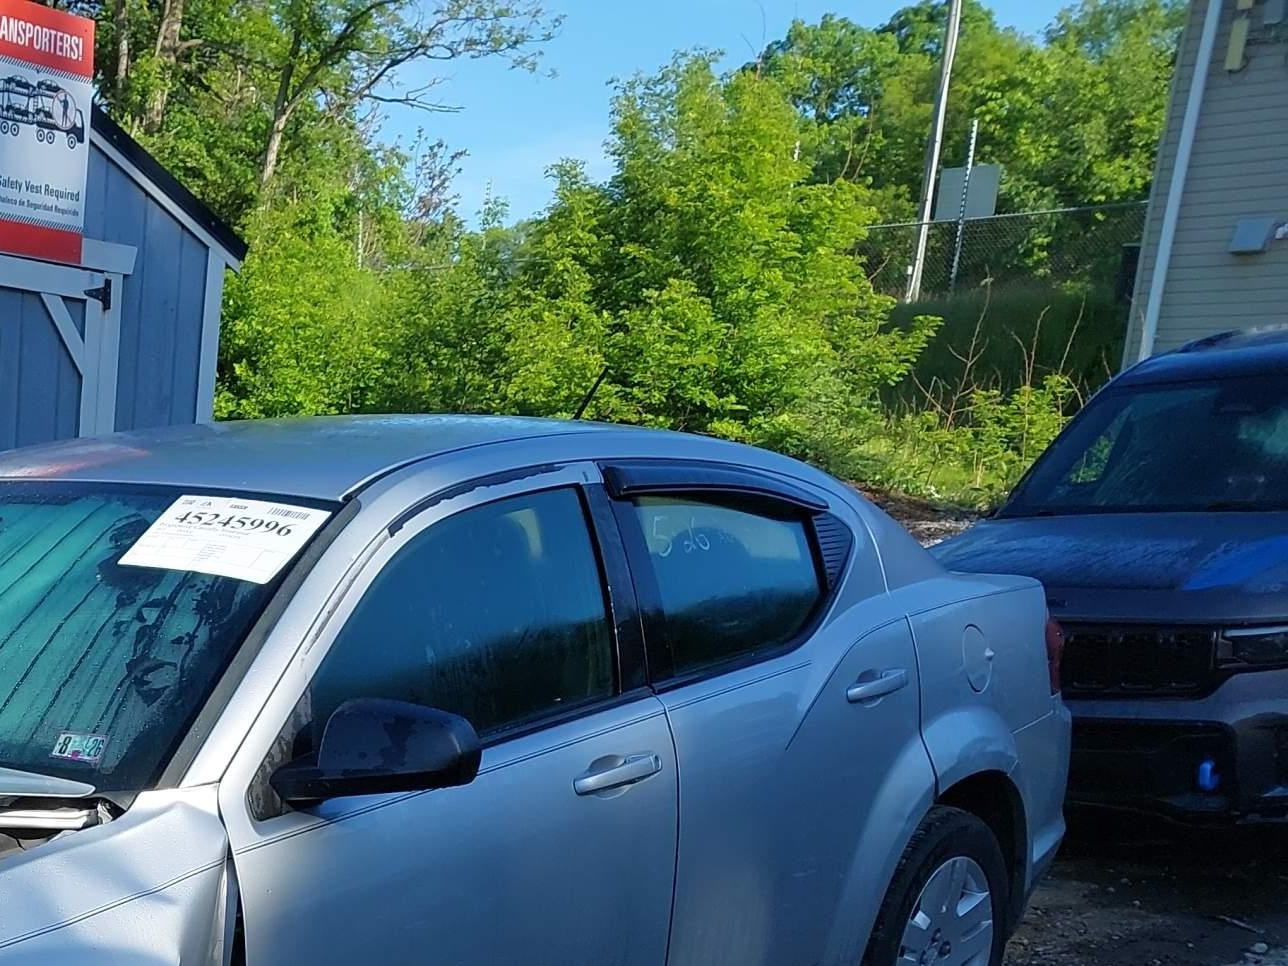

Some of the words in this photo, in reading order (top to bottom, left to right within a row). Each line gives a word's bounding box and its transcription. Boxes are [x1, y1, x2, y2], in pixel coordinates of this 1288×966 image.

[25, 180, 42, 195] Vest
[44, 183, 80, 202] Required
[174, 511, 298, 537] 45245996
